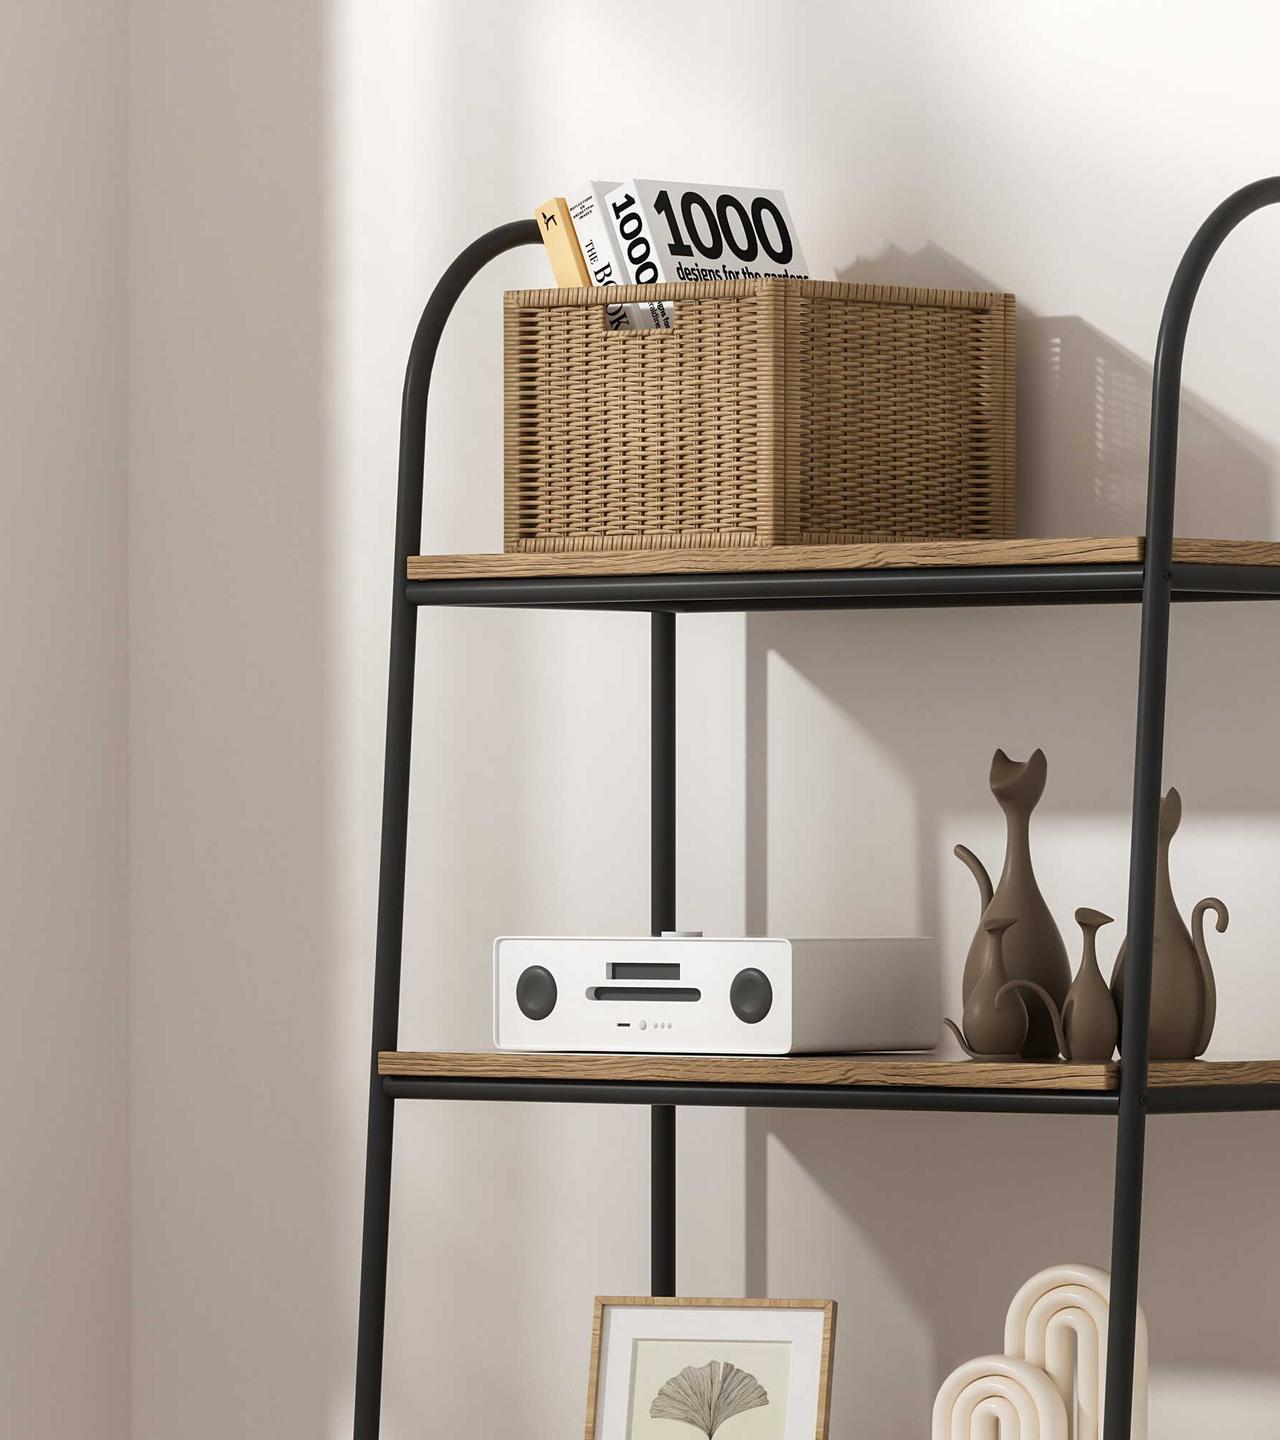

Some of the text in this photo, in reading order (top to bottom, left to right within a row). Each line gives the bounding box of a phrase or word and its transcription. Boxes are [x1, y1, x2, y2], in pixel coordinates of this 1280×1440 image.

[584, 239, 599, 265] THE
[612, 193, 658, 285] 1000
[653, 190, 793, 264] 1000
[677, 262, 720, 281] designs
[722, 265, 742, 280] for
[742, 267, 761, 279] the
